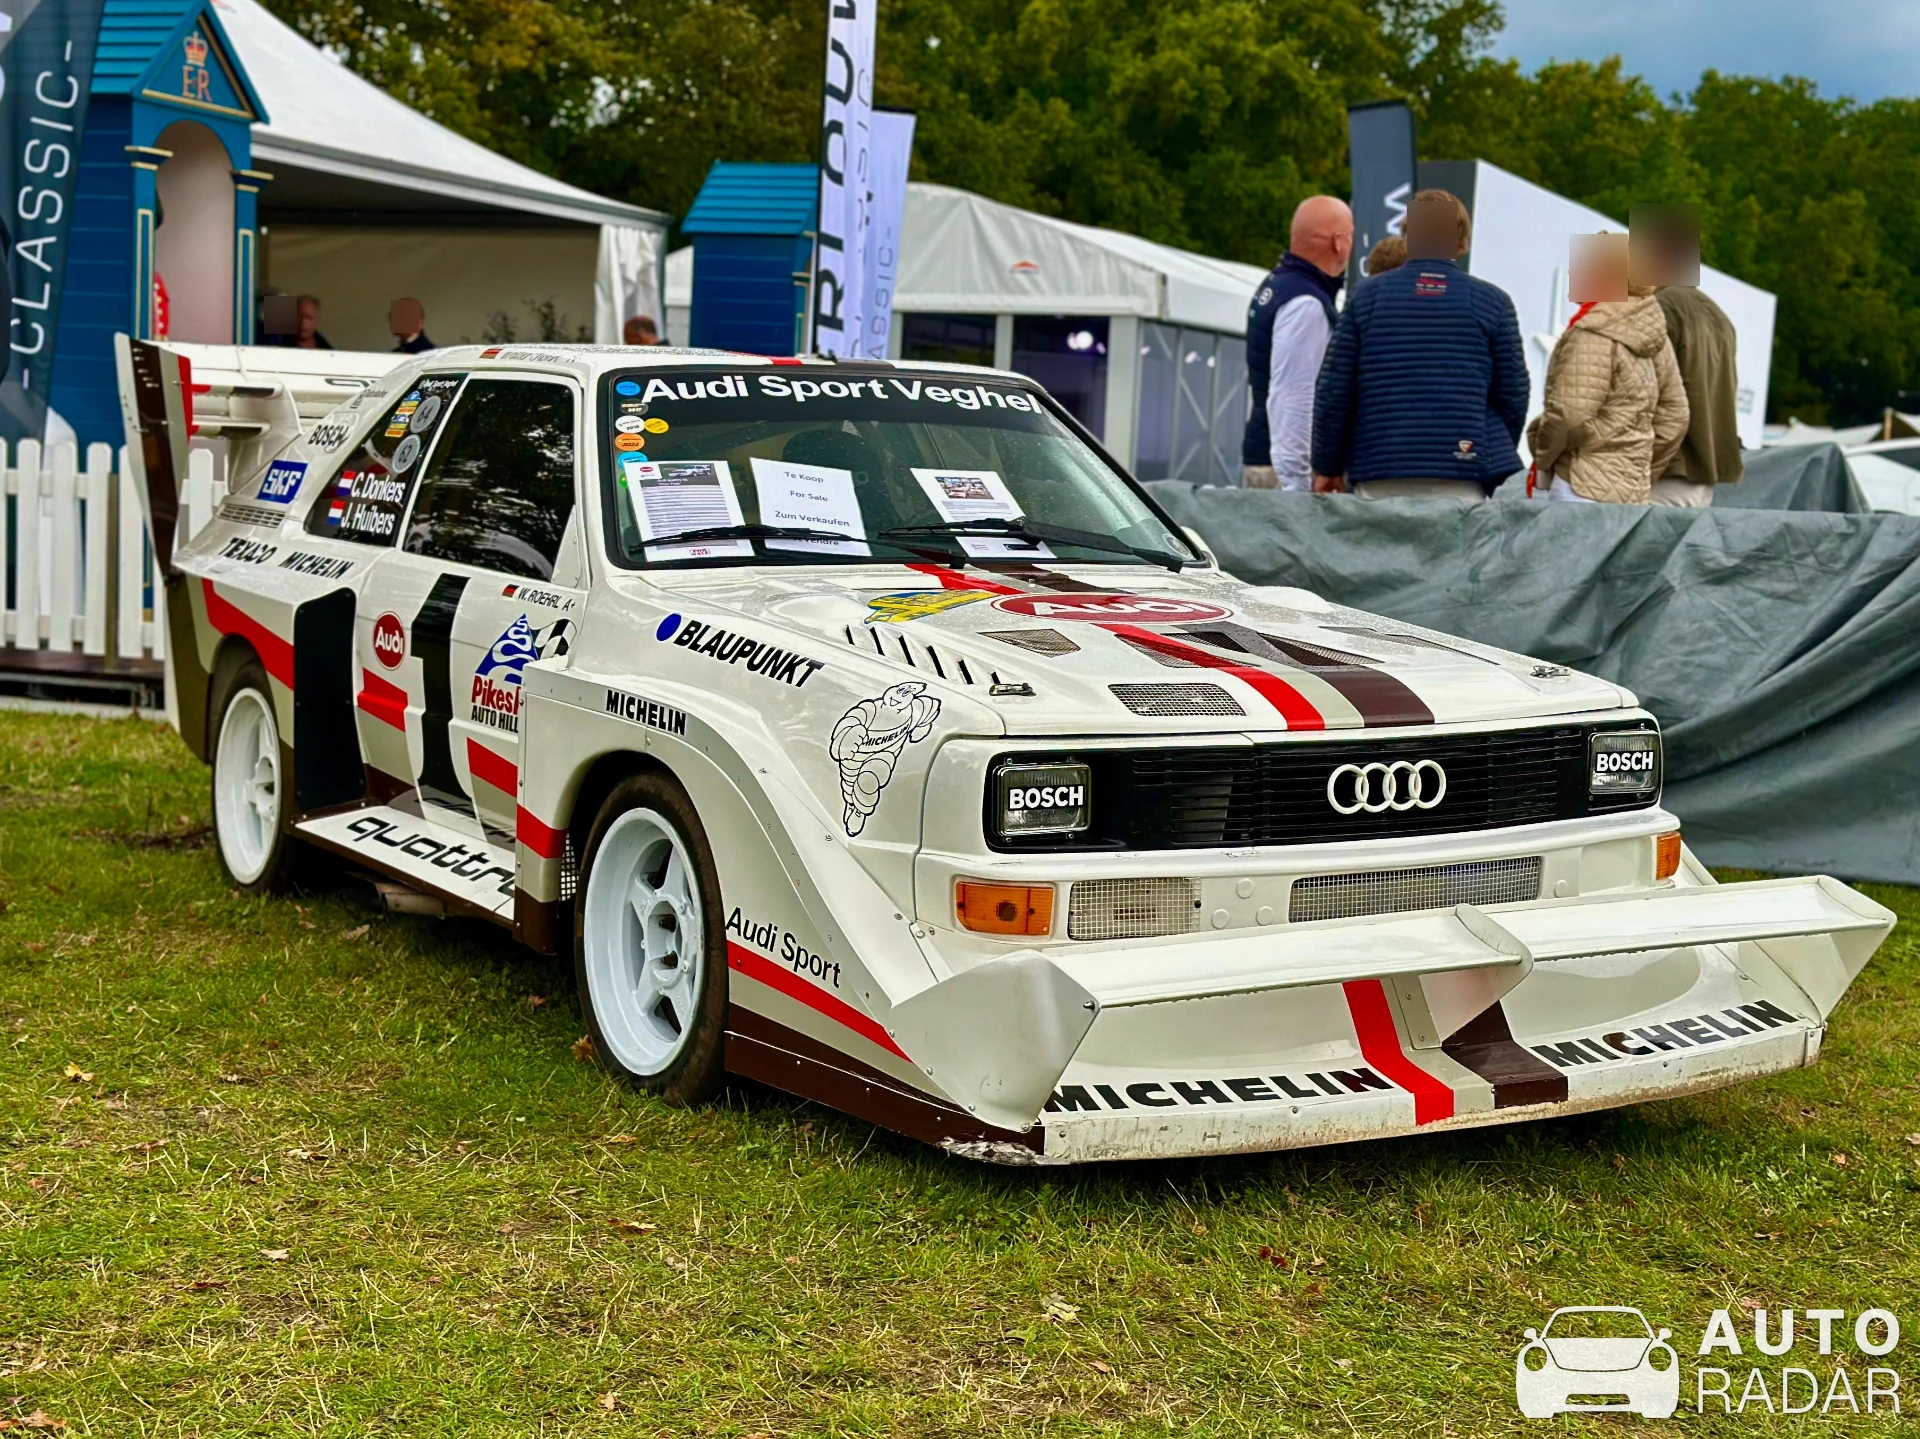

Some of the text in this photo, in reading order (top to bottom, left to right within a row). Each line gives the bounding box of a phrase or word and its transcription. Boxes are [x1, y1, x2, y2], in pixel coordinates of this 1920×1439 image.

[641, 376, 749, 403] Audi
[760, 376, 889, 402] Sport
[889, 378, 1042, 414] Veghel
[308, 425, 349, 447] BOSCH
[262, 468, 302, 495] SKF
[351, 472, 406, 503] C. Donkers
[784, 471, 824, 483] Te Koop
[789, 490, 828, 502] For Sale
[340, 502, 396, 535] J. Huibers
[775, 510, 850, 527] Zum Verkaufen
[218, 537, 355, 580] TEXACO MICHELIN
[1029, 600, 1217, 616] Audi
[375, 627, 404, 655] Audi
[672, 620, 825, 688] BLAUPUNKT
[411, 573, 477, 812] 1
[471, 705, 519, 734] AUTO HILL
[605, 689, 687, 737] MICHELIN
[863, 723, 910, 748] MICHELIN
[1596, 751, 1654, 772] BOSCH
[1009, 785, 1084, 810] BOSCH
[725, 907, 841, 989] Audi Sport
[1529, 999, 1800, 1068] MICHELIN
[1042, 1067, 1394, 1113] MICHELIN
